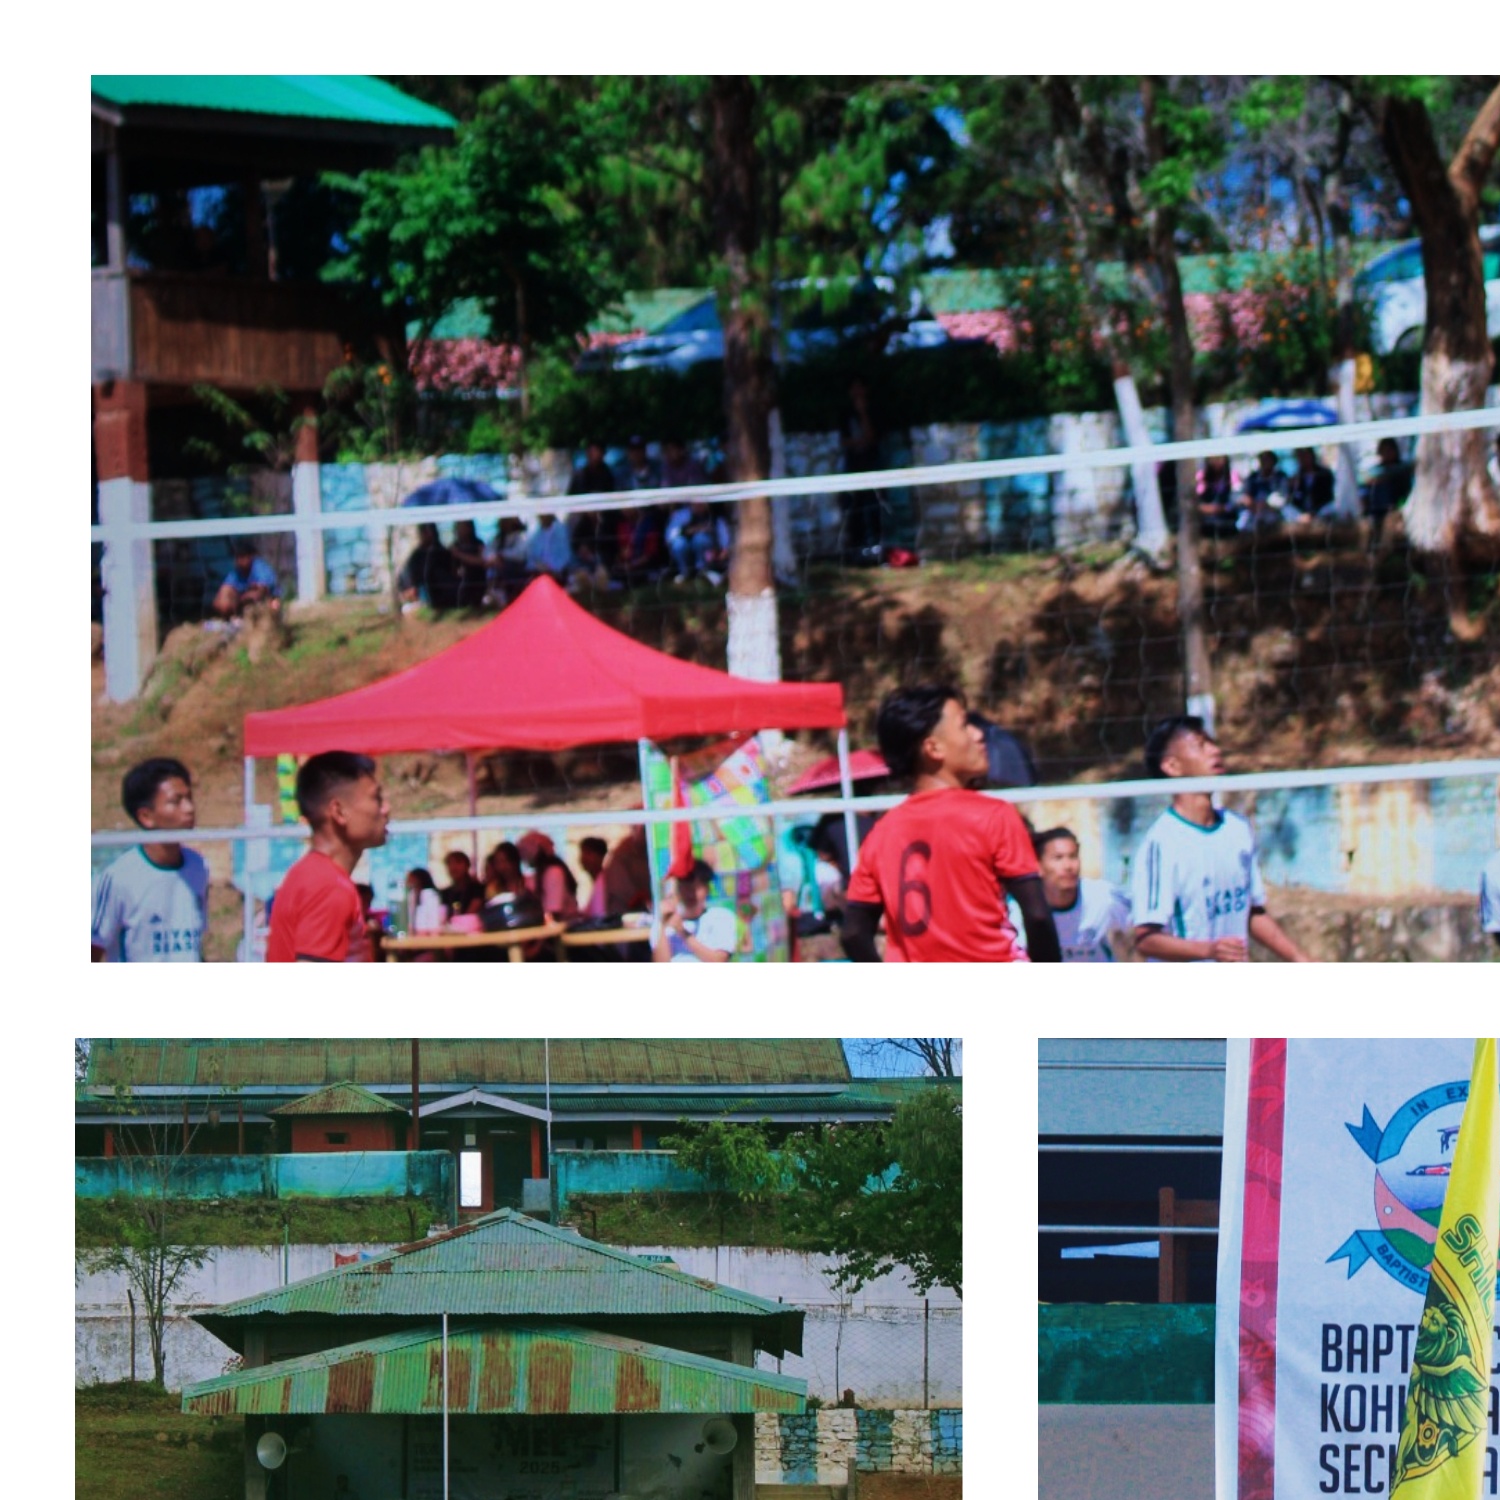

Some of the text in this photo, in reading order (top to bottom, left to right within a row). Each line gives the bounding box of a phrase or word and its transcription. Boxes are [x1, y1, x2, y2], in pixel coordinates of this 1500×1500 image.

[1410, 1100, 1430, 1118] IN
[1376, 1243, 1428, 1289] BAPTIST
[1321, 1323, 1415, 1374] BAPT
